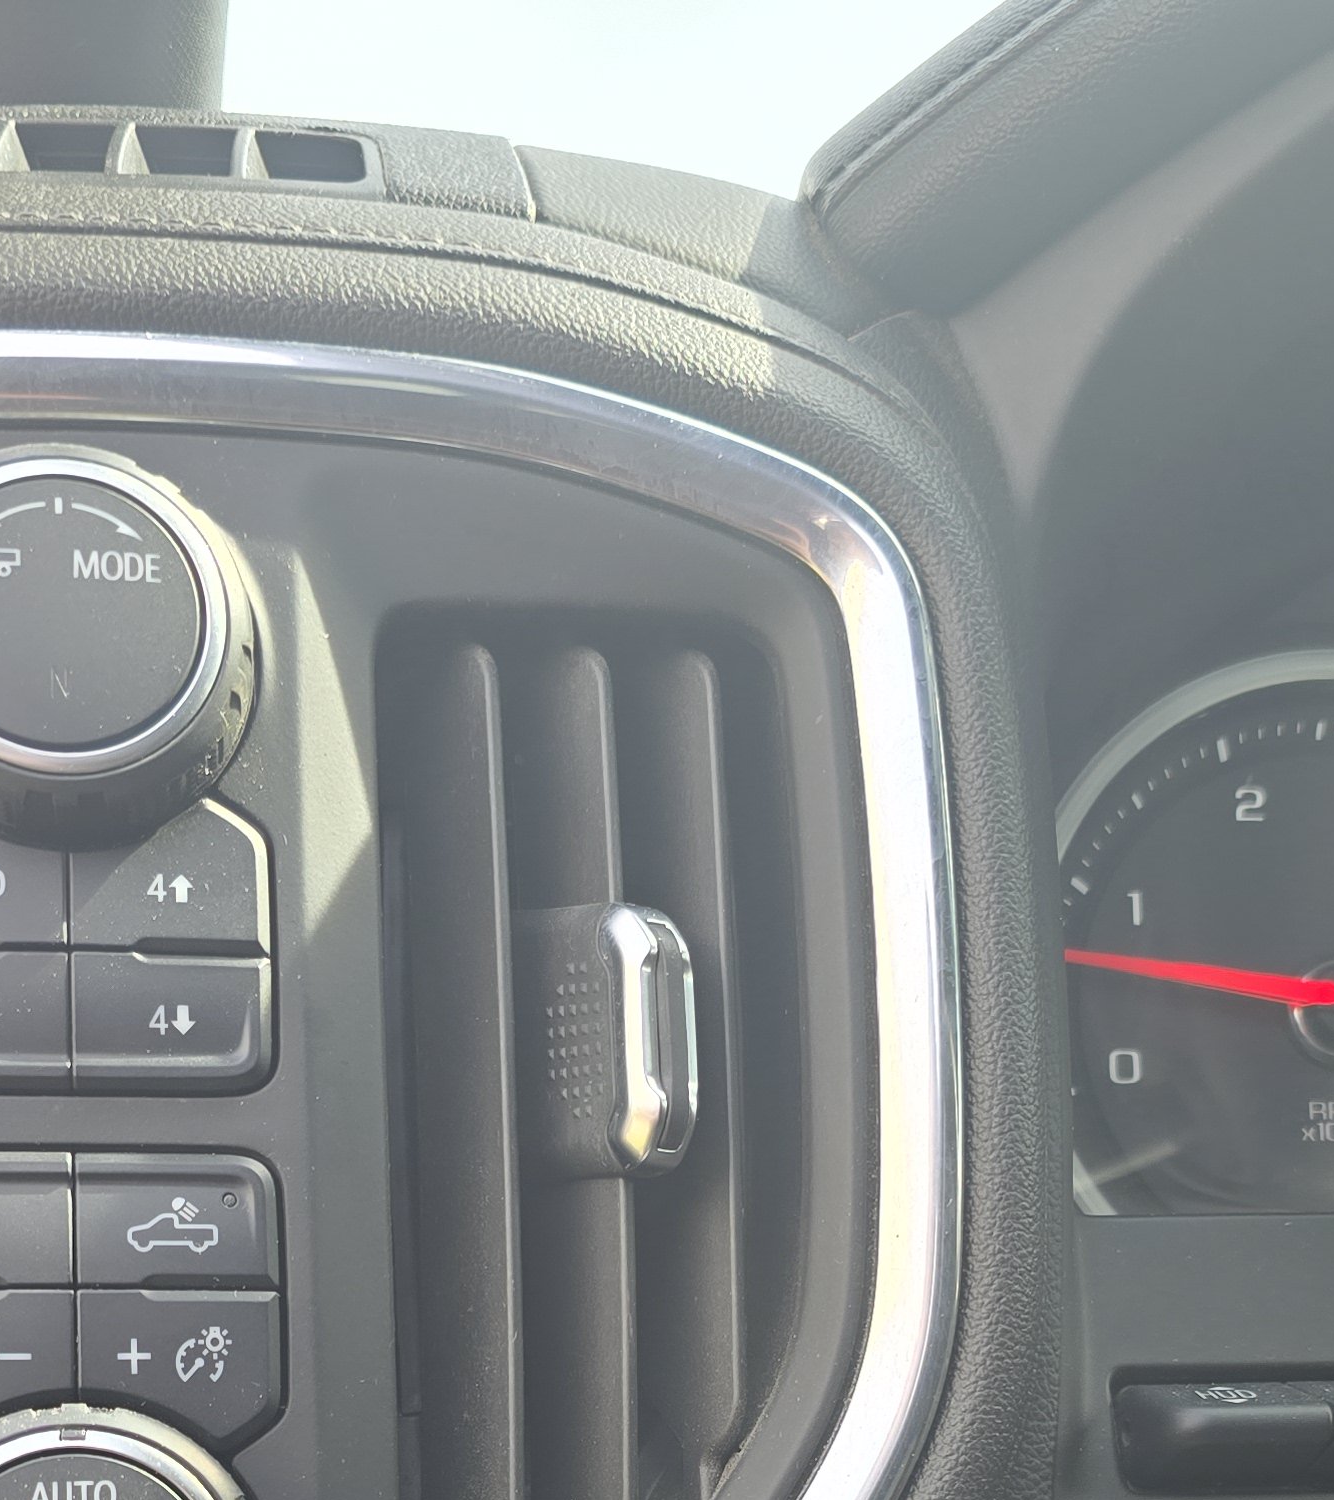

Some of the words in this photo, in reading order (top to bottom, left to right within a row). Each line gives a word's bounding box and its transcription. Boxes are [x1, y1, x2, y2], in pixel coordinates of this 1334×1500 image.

[72, 550, 162, 584] MODE
[1235, 786, 1267, 822] 2
[146, 873, 167, 902] 4
[1127, 890, 1143, 926] 1
[148, 1005, 169, 1035] 4
[1108, 1049, 1142, 1084] 0
[1194, 1388, 1258, 1400] HUD
